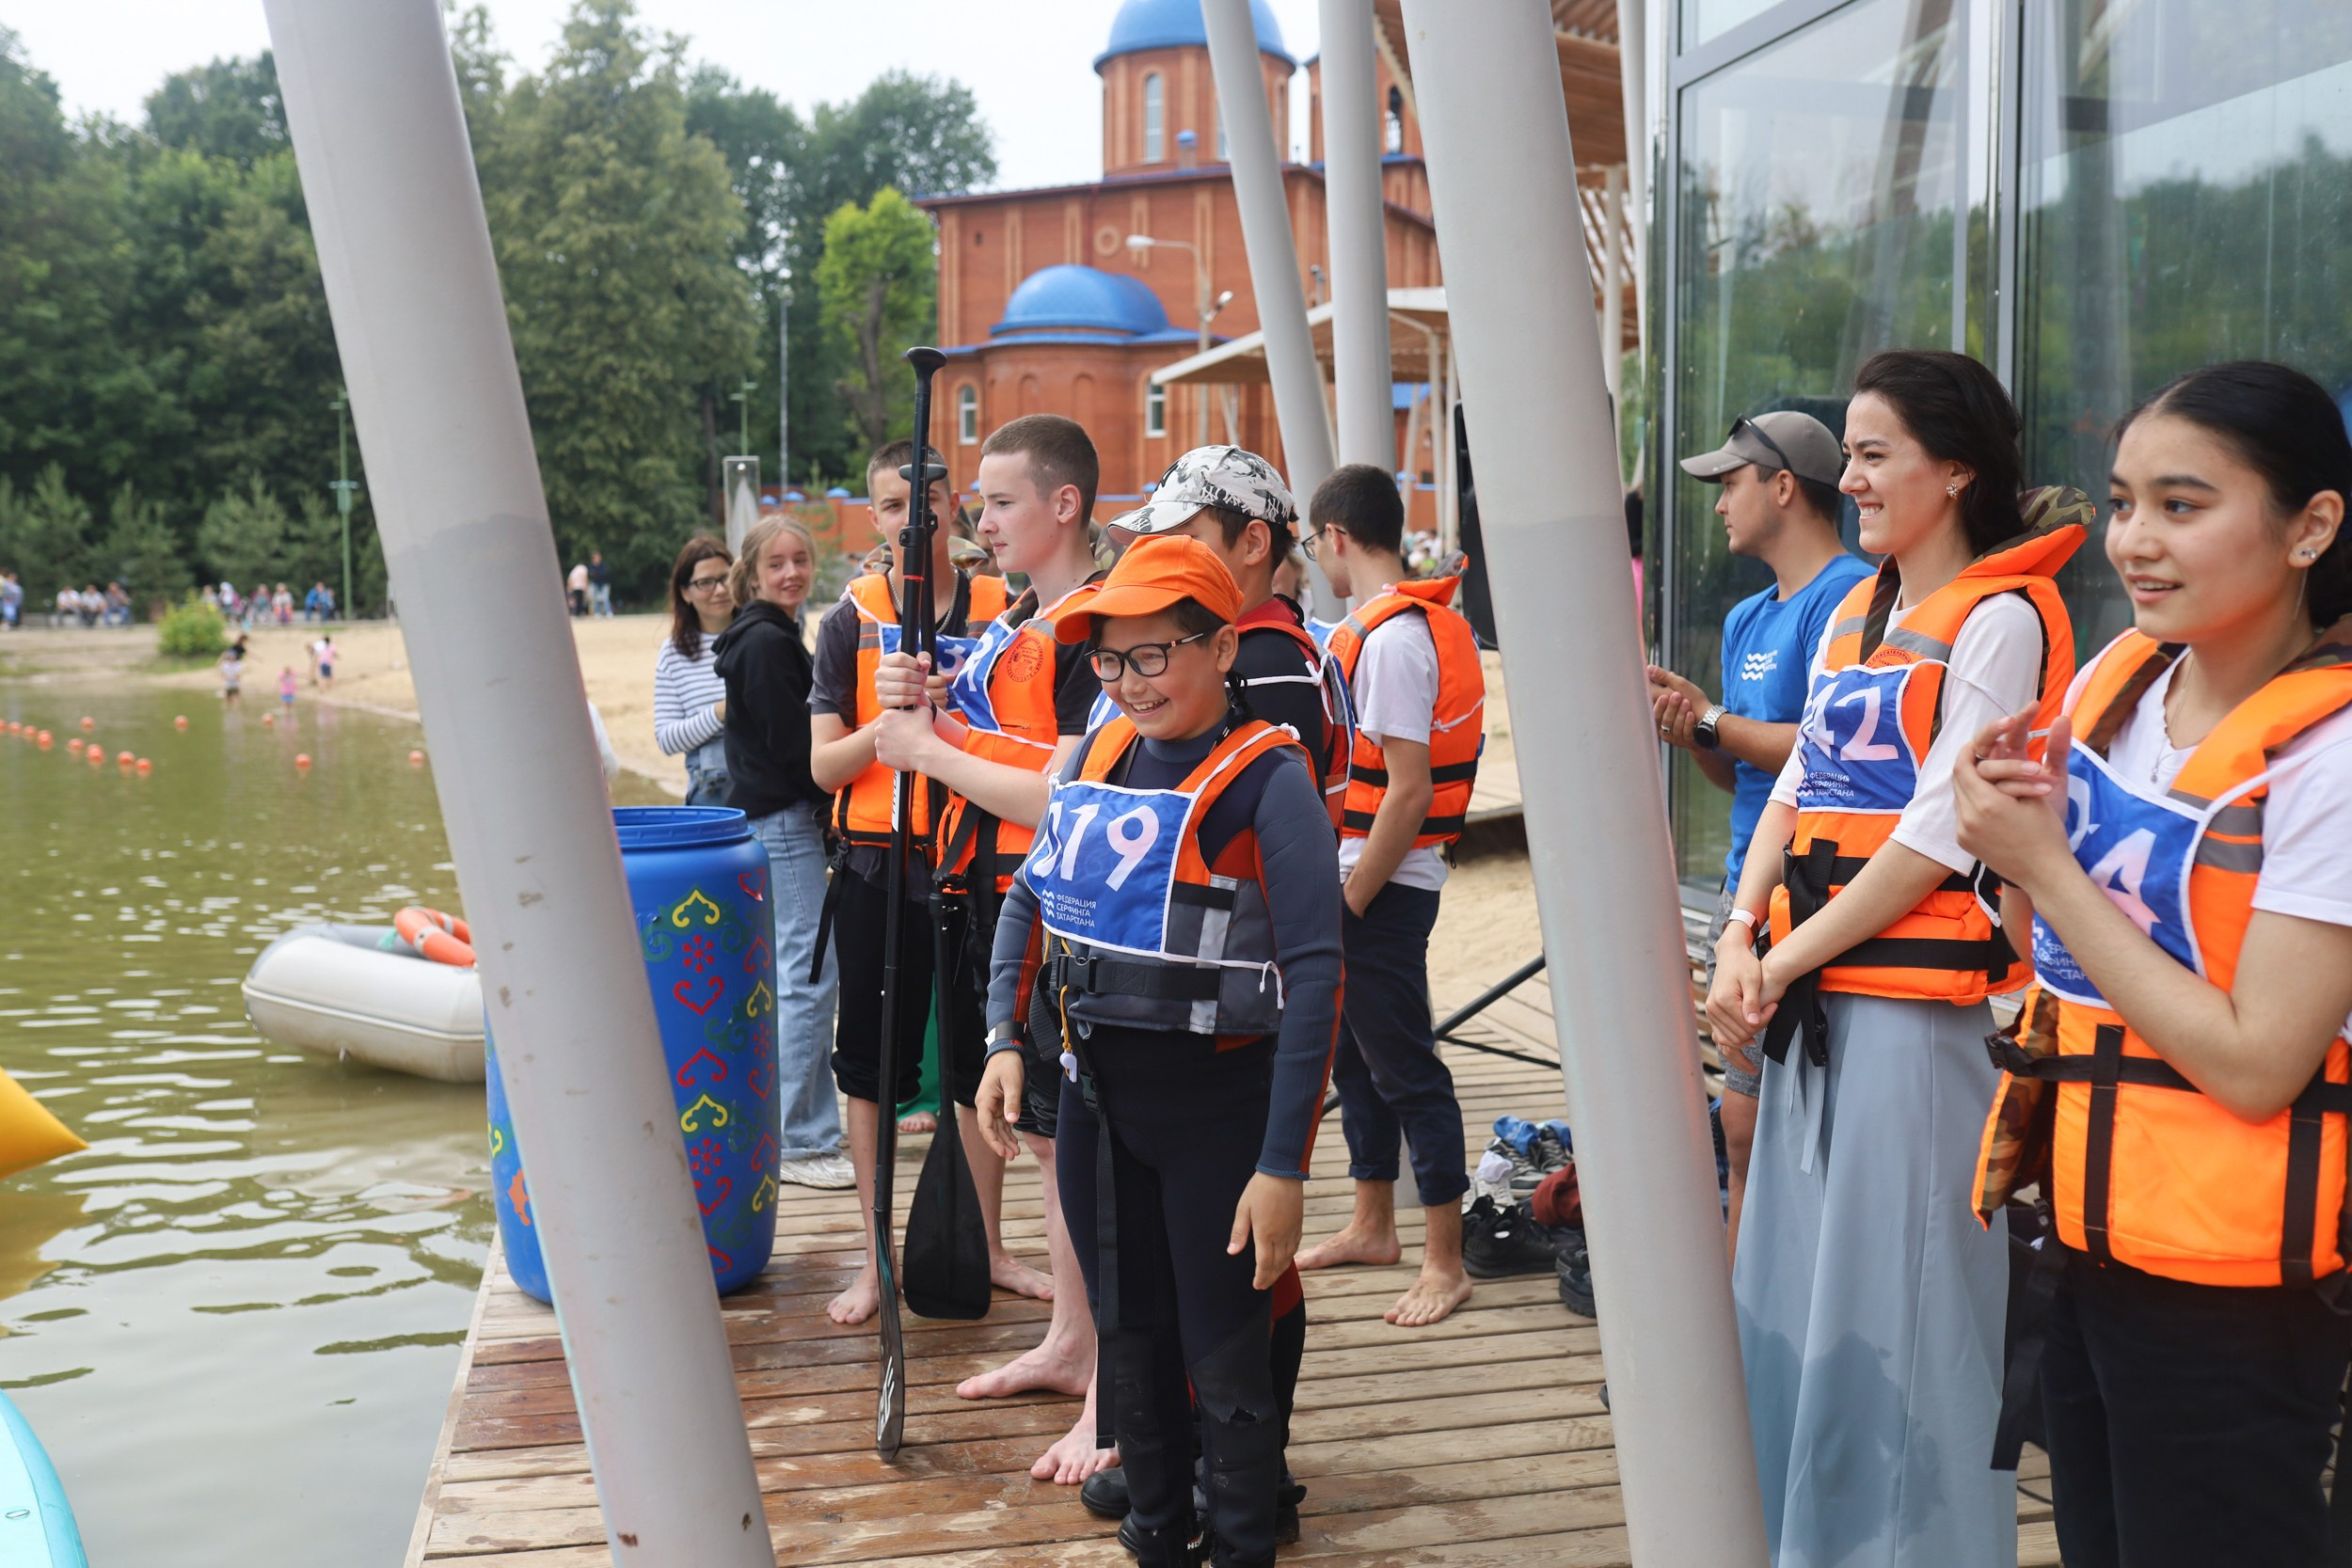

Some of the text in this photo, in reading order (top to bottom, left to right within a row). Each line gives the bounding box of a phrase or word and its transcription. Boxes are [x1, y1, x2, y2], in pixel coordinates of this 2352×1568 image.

[1057, 895, 1096, 909] ФЕДЕРАЦИЯ
[1057, 903, 1091, 917] СЕРФИНГА
[1057, 912, 1095, 927] ТАТАРСТАНА
